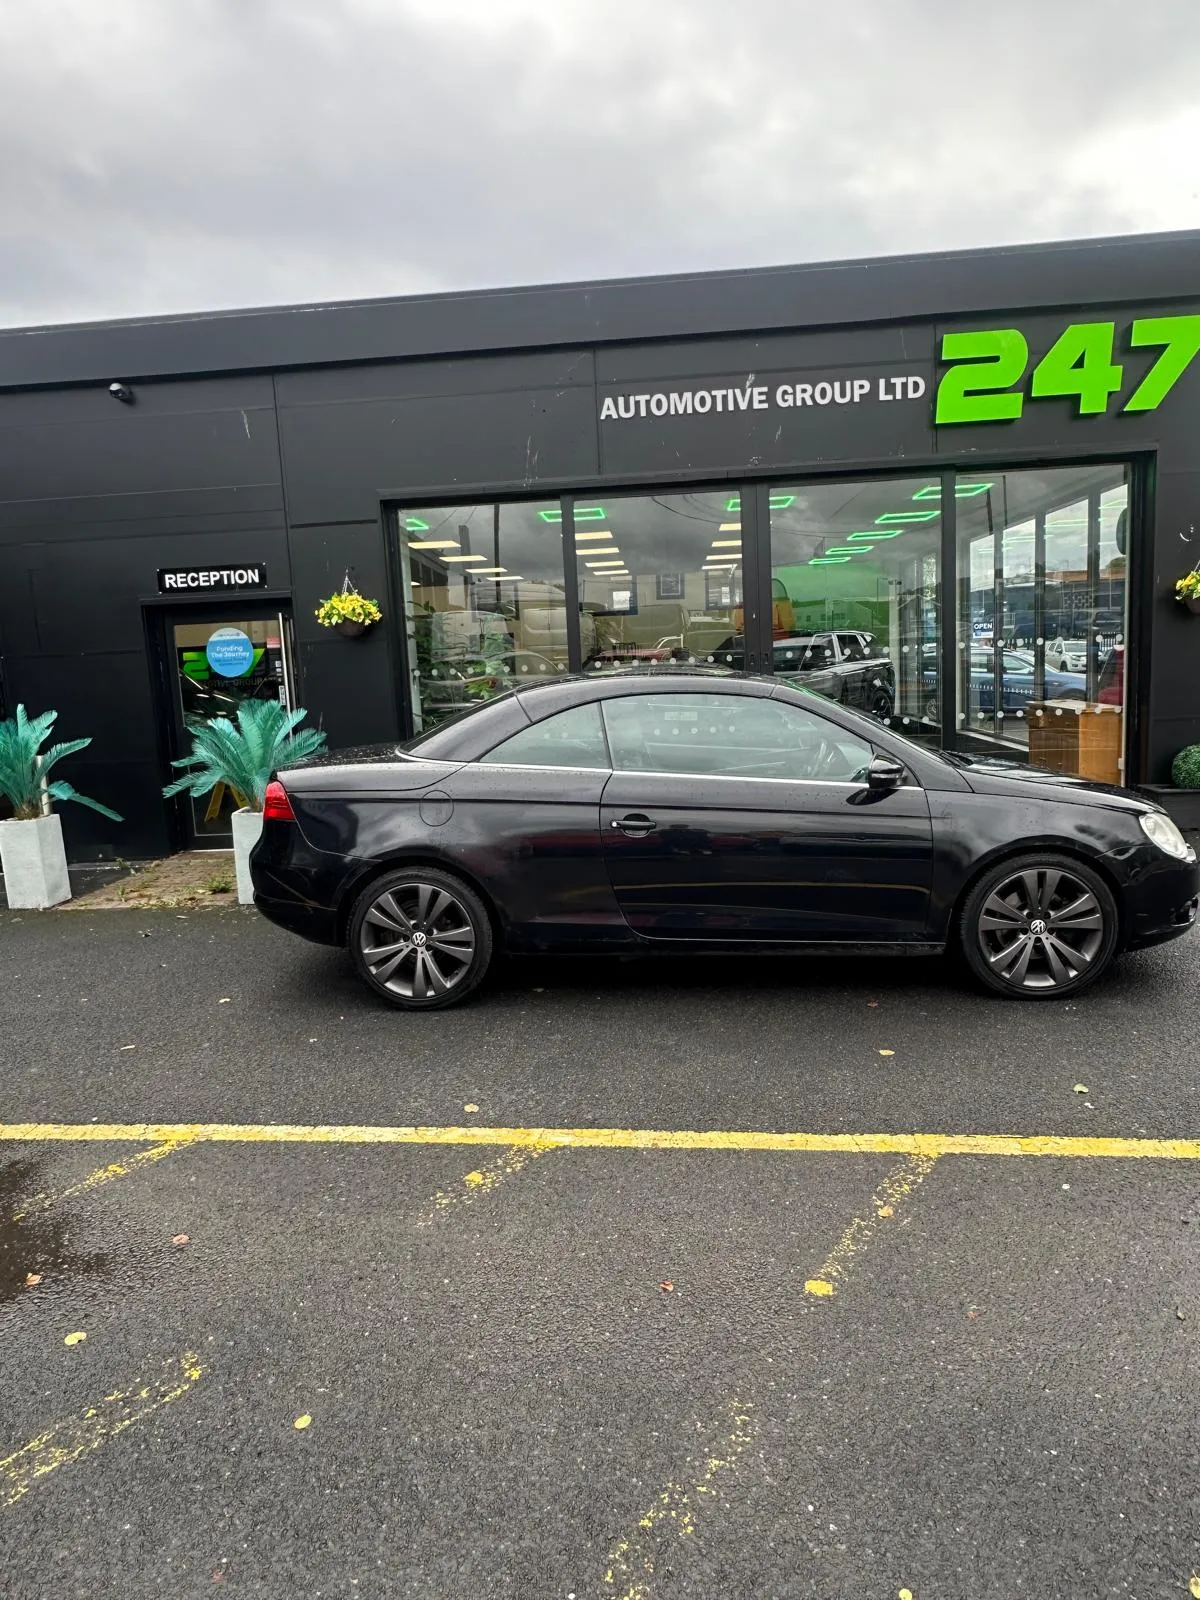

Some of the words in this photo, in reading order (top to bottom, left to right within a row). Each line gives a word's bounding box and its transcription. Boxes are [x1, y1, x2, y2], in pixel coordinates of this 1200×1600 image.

[936, 314, 1200, 424] 247
[600, 386, 769, 420] AUTOMOTIVE
[775, 379, 871, 408] GROUP
[878, 376, 926, 401] LTD
[164, 568, 260, 588] RECEPTION
[974, 622, 993, 630] OPEN
